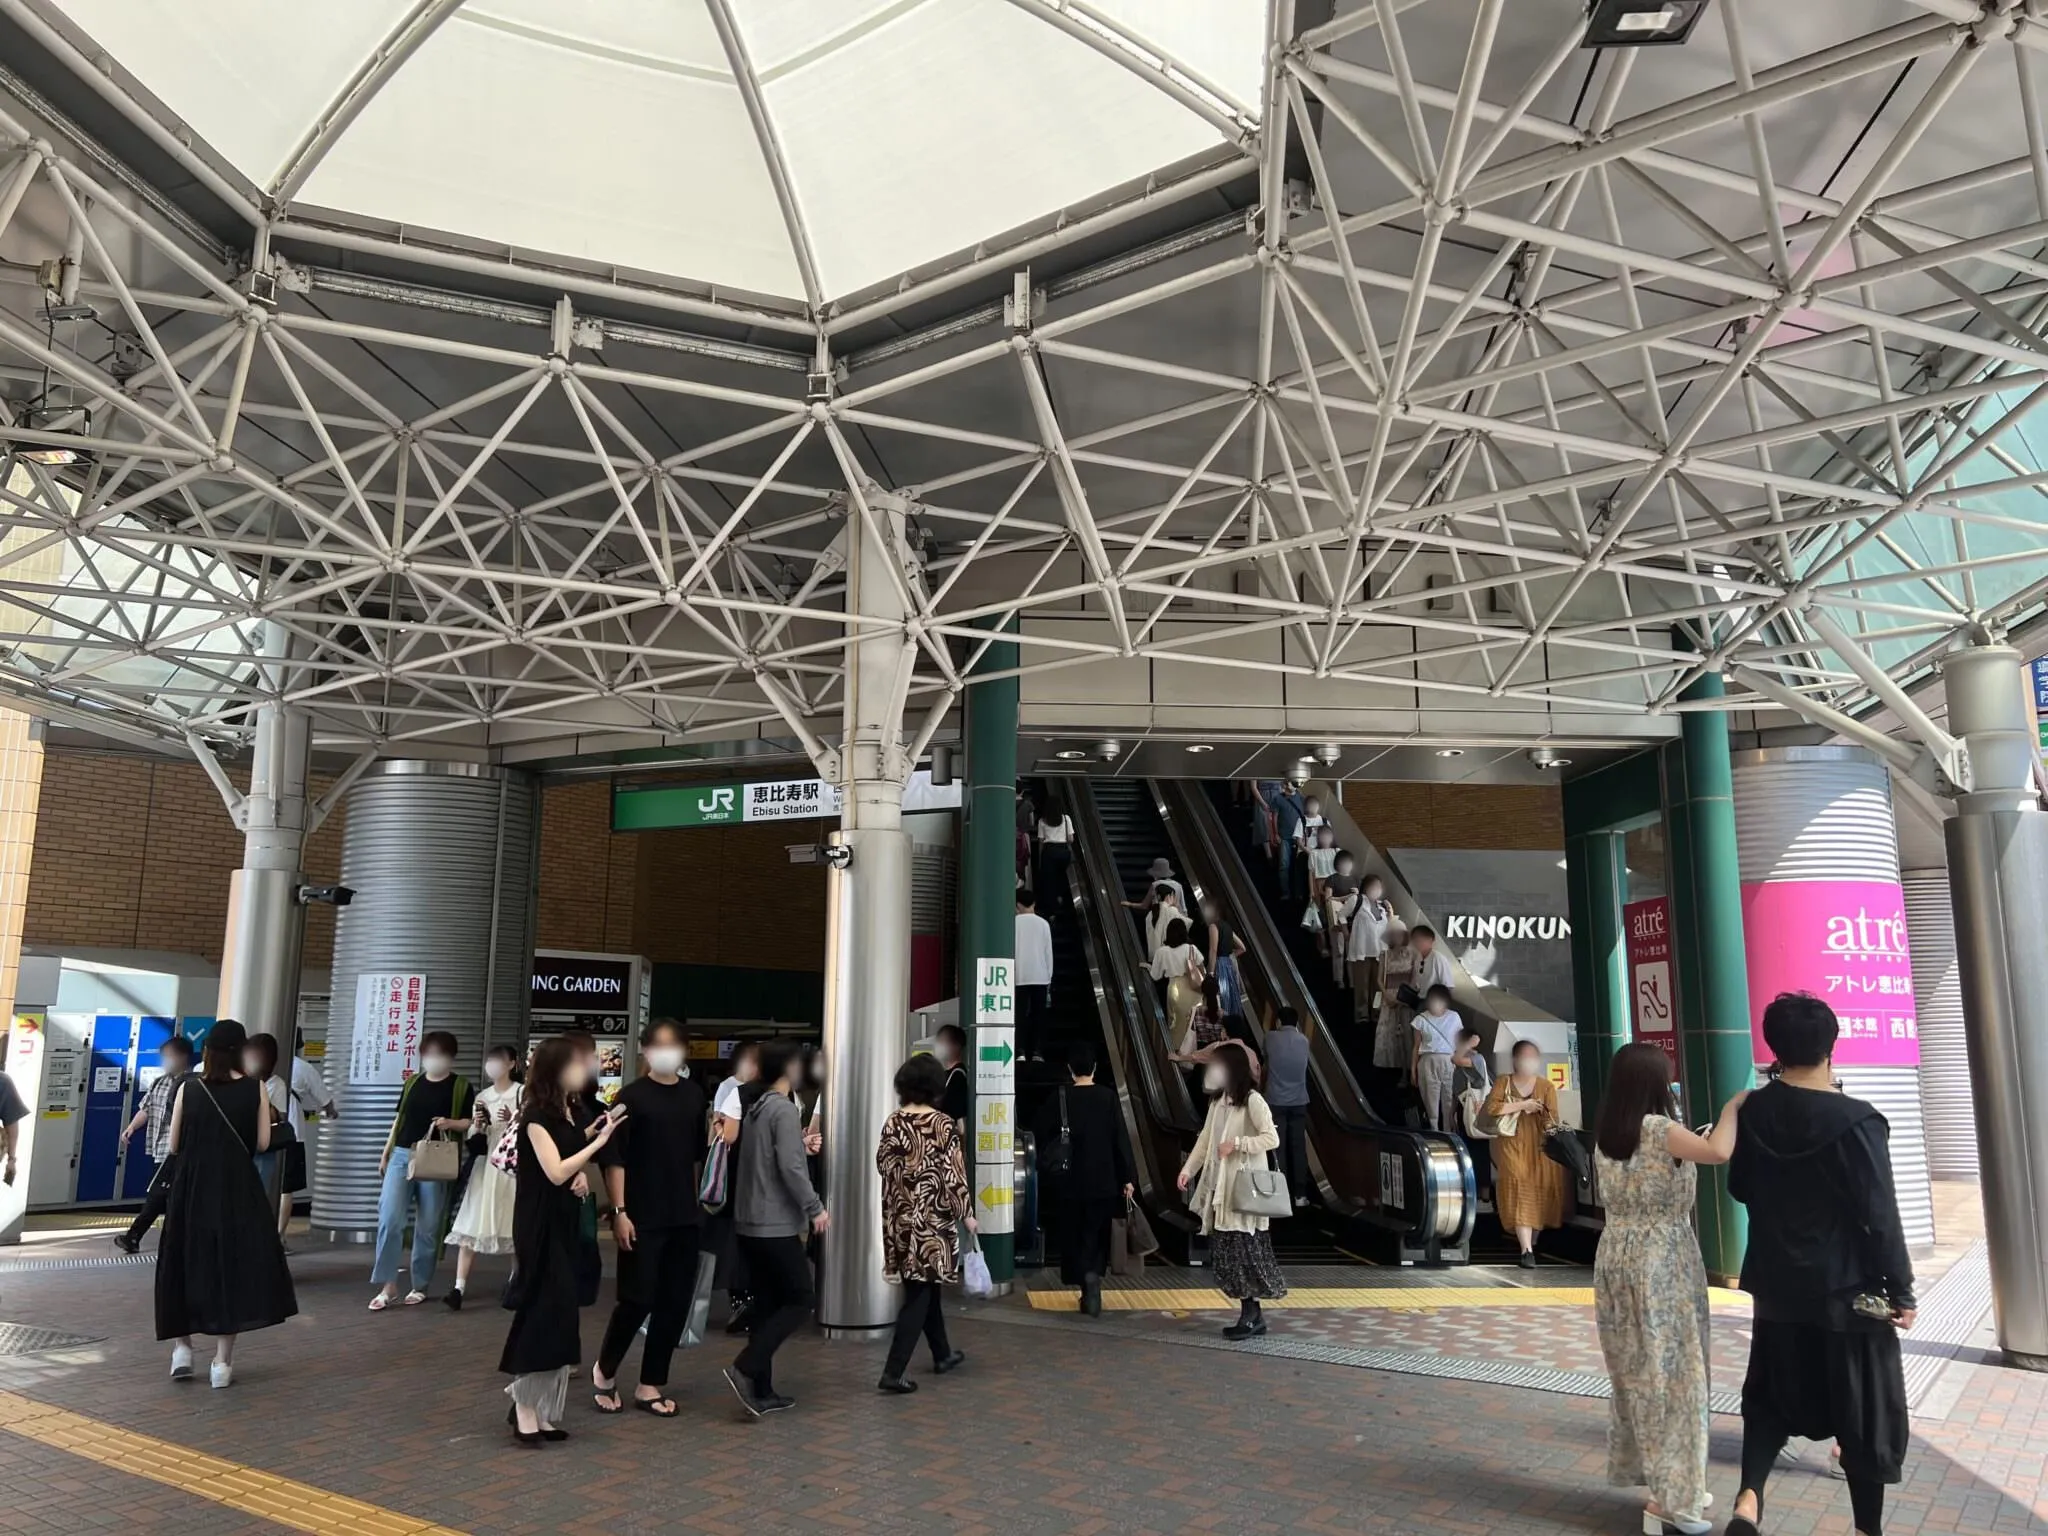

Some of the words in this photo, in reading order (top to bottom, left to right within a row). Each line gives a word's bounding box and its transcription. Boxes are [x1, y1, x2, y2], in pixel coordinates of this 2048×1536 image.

[698, 788, 734, 812] JR
[753, 783, 819, 803] 恵比寿駅
[752, 806, 780, 817] Ebisu
[783, 804, 818, 815] Station
[1447, 915, 1571, 939] KINOKUN
[1634, 906, 1665, 936] atré
[1827, 907, 1906, 952] atré
[563, 976, 621, 993] GARDEN
[984, 966, 1008, 986] JR
[979, 993, 1012, 1013] 東口
[386, 991, 402, 1053] 走行禁止
[982, 1102, 1008, 1125] JR
[978, 1131, 1012, 1152] 西口
